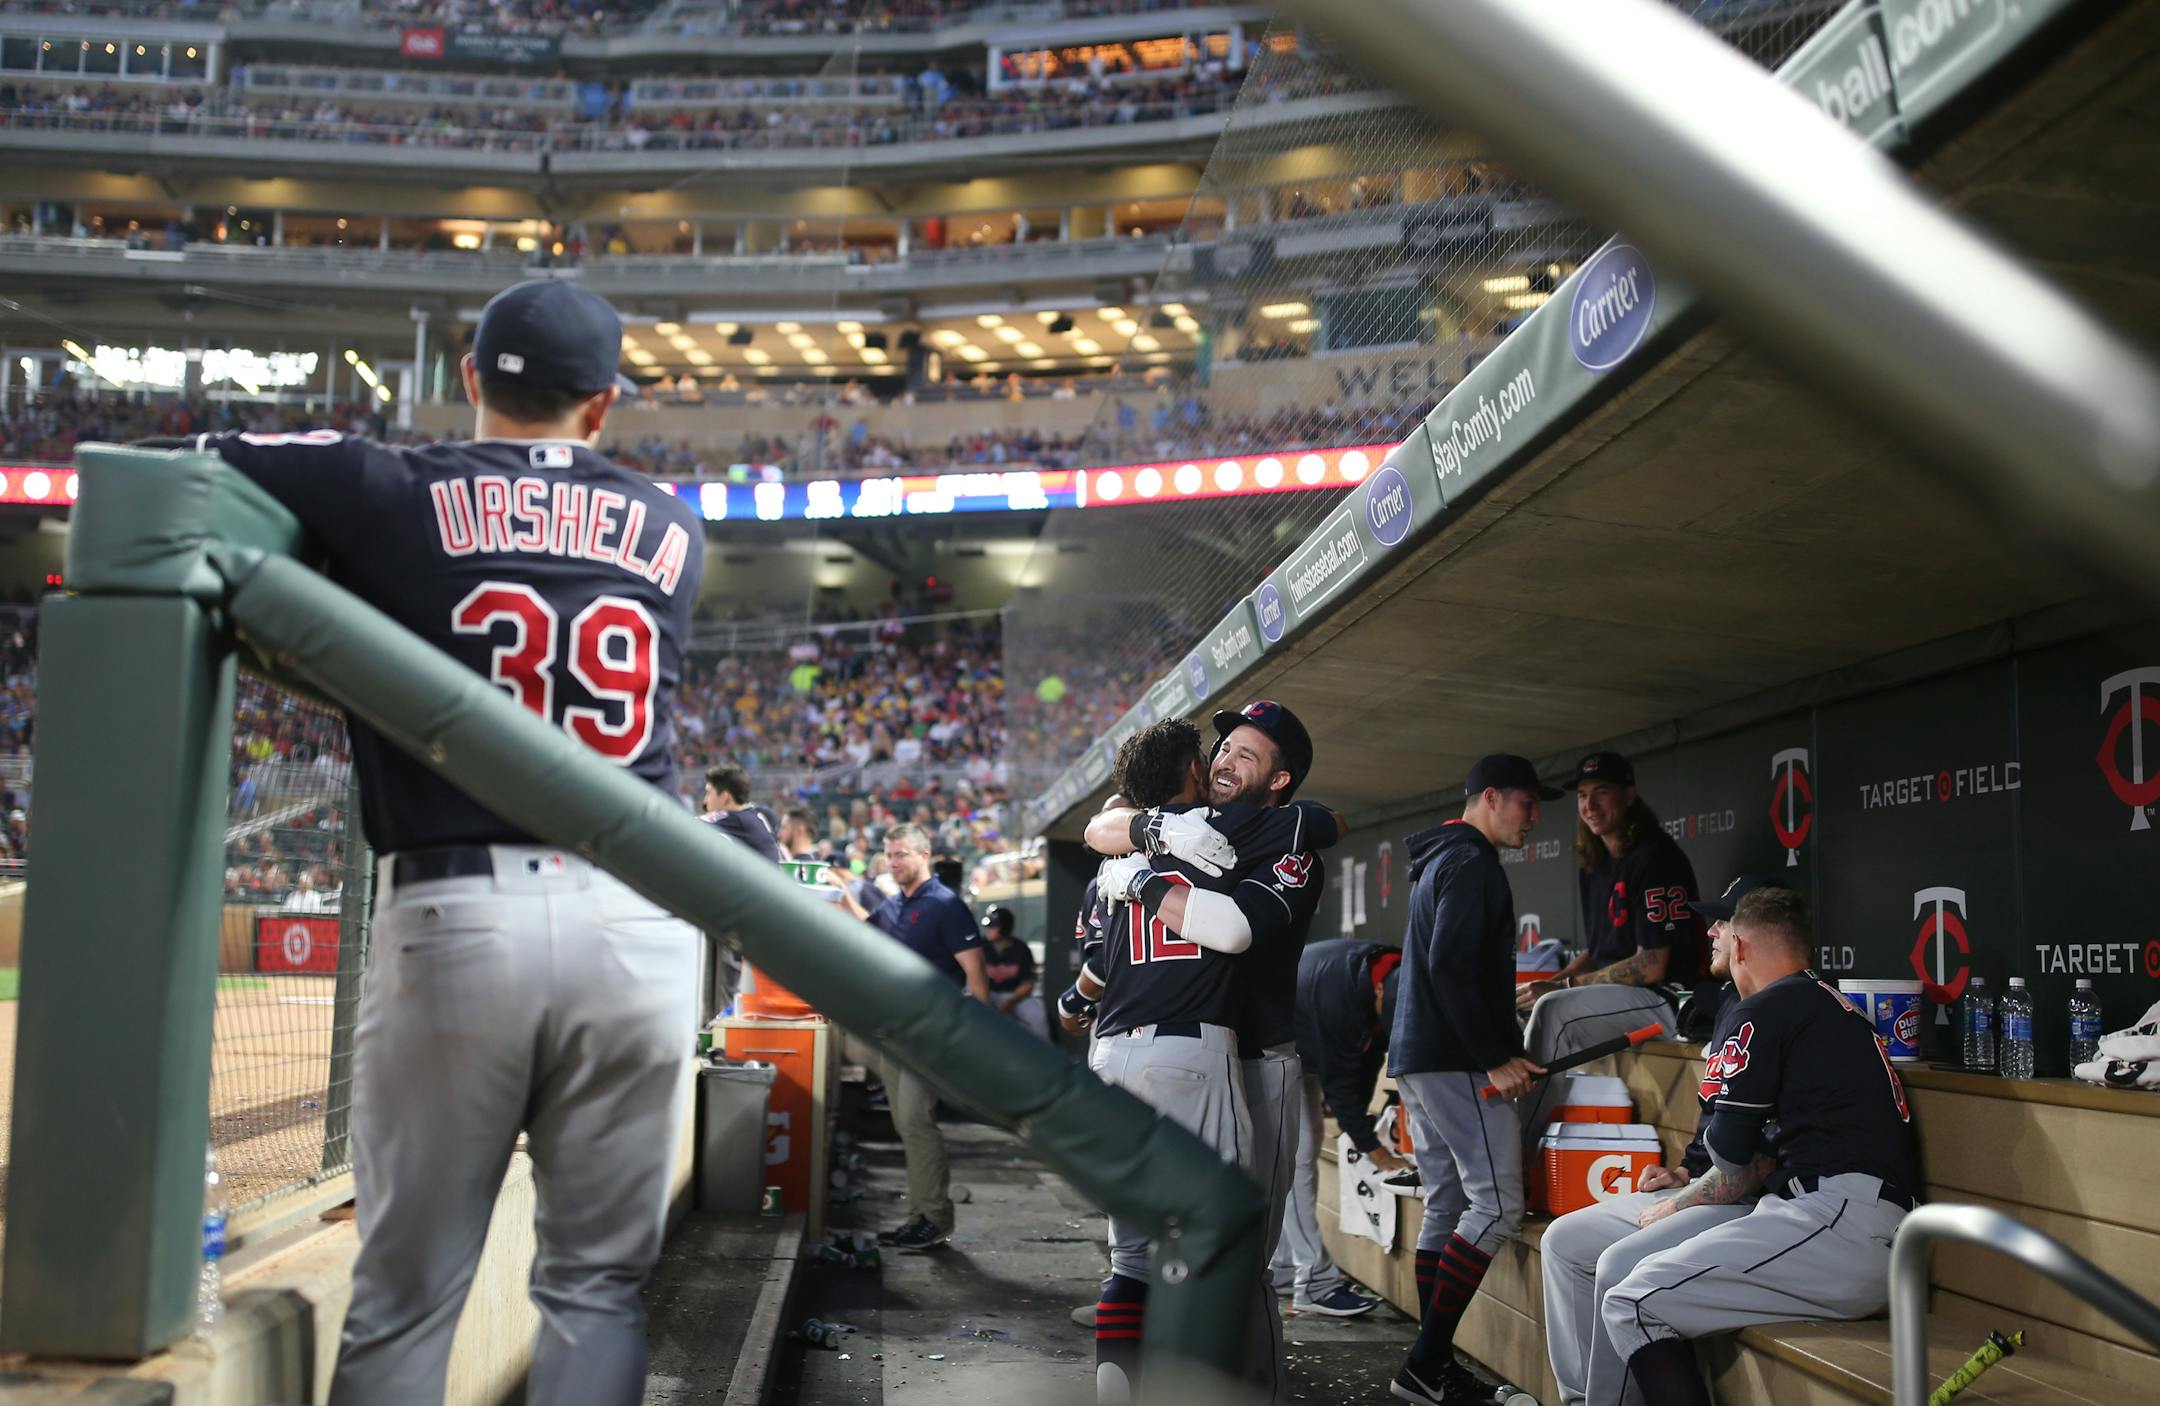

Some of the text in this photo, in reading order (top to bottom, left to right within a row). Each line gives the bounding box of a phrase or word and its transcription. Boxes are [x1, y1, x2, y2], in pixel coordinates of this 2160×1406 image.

[1577, 265, 1640, 348] Carrier
[1431, 366, 1537, 481] StayComfy.com
[1370, 482, 1406, 529] Carrier
[429, 475, 690, 596] URSHELA
[1289, 528, 1360, 604] twinsbaseball.com
[451, 580, 661, 767] 39
[1859, 761, 2022, 809] TARGET FIELD
[1659, 808, 1735, 841] GET FIELD
[1535, 839, 1560, 861] FIELD
[1127, 871, 1202, 965] 12
[1644, 885, 1691, 923] 52
[1821, 945, 1855, 971] ELD
[2035, 942, 2140, 975] TARGET
[1586, 1154, 1633, 1202] G
